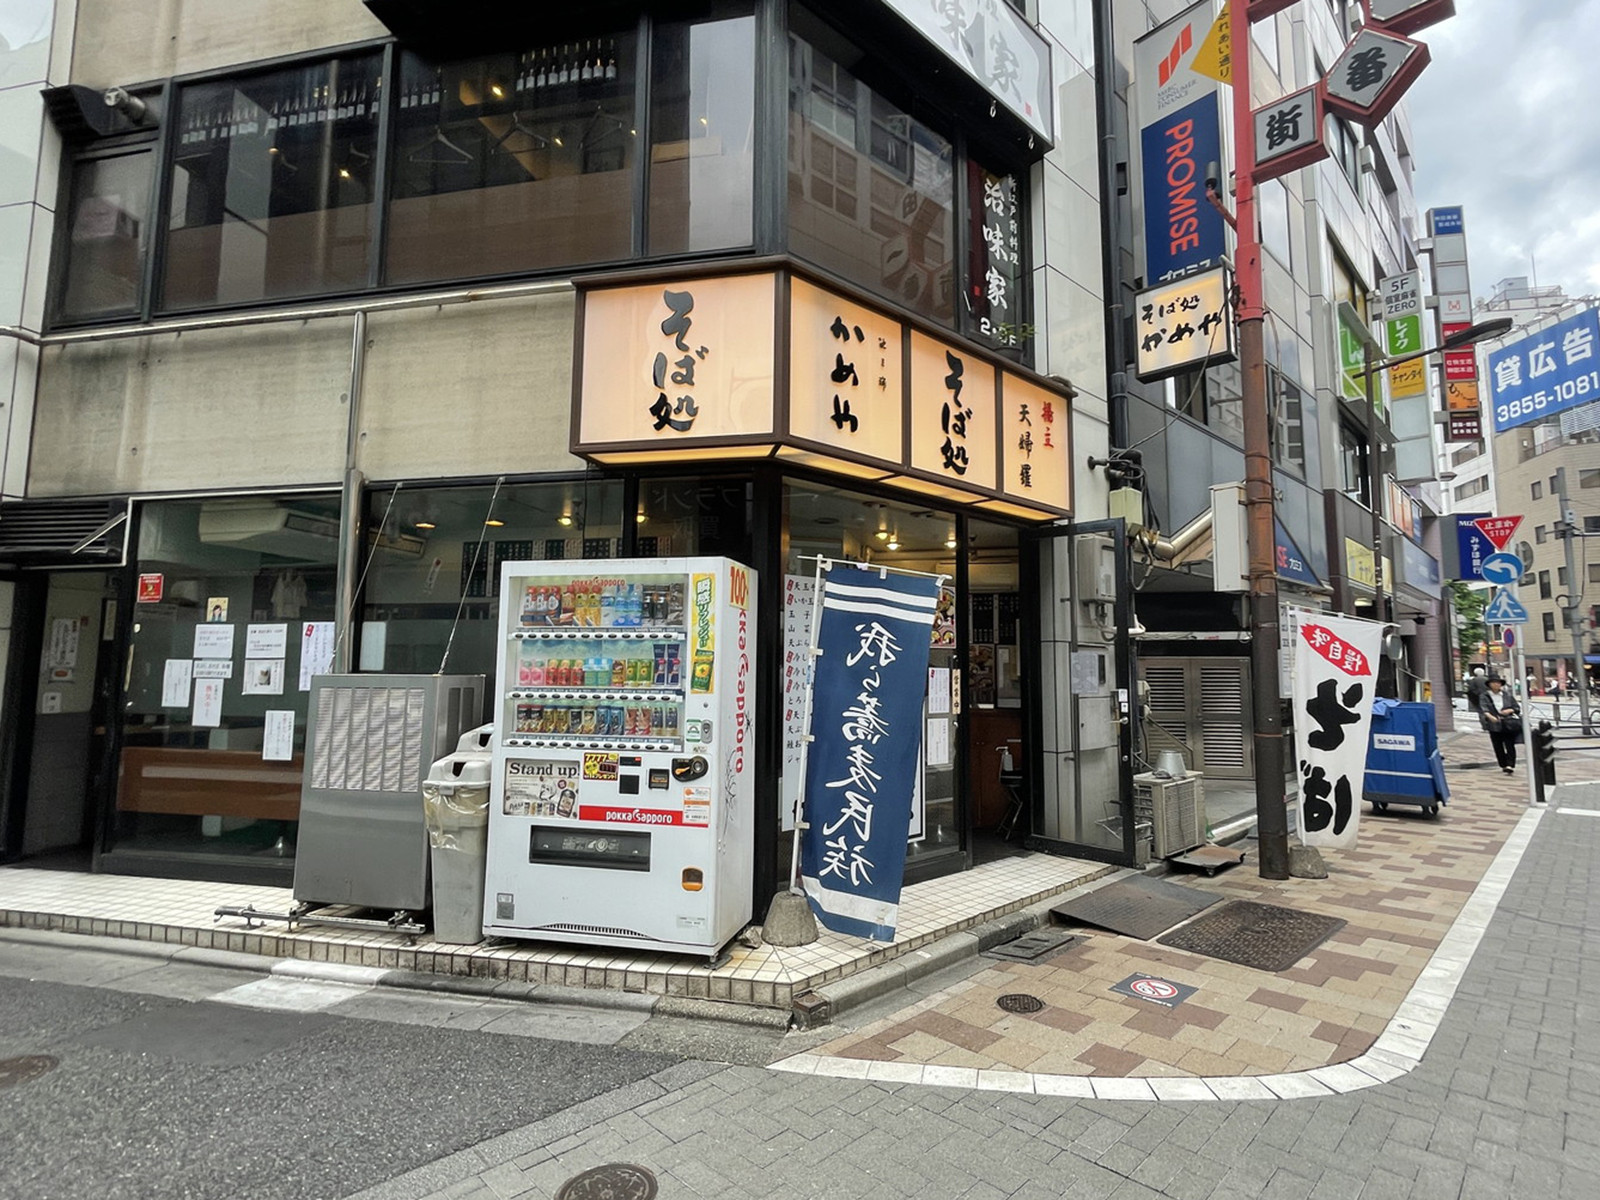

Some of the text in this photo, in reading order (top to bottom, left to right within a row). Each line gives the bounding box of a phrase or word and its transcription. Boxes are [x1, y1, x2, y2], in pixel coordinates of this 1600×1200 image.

[1265, 46, 1388, 150] 番 街
[1165, 119, 1200, 256] PROMISE
[1391, 278, 1409, 292] 5F
[1141, 295, 1201, 325] そば処
[1387, 300, 1417, 314] ZERO
[1141, 312, 1222, 352] かめや
[1395, 320, 1409, 350] レイク
[649, 290, 710, 432] そば処
[830, 316, 865, 433] かめや
[1494, 327, 1593, 393] 貸広告
[940, 350, 974, 476] そば処
[1497, 371, 1600, 423] 3855-1081
[1018, 404, 1034, 488] 天婦羅
[1484, 519, 1514, 530] 止まれ
[1489, 529, 1511, 537] STOP
[1376, 737, 1411, 748] SAGAWA
[509, 762, 553, 776] Stand
